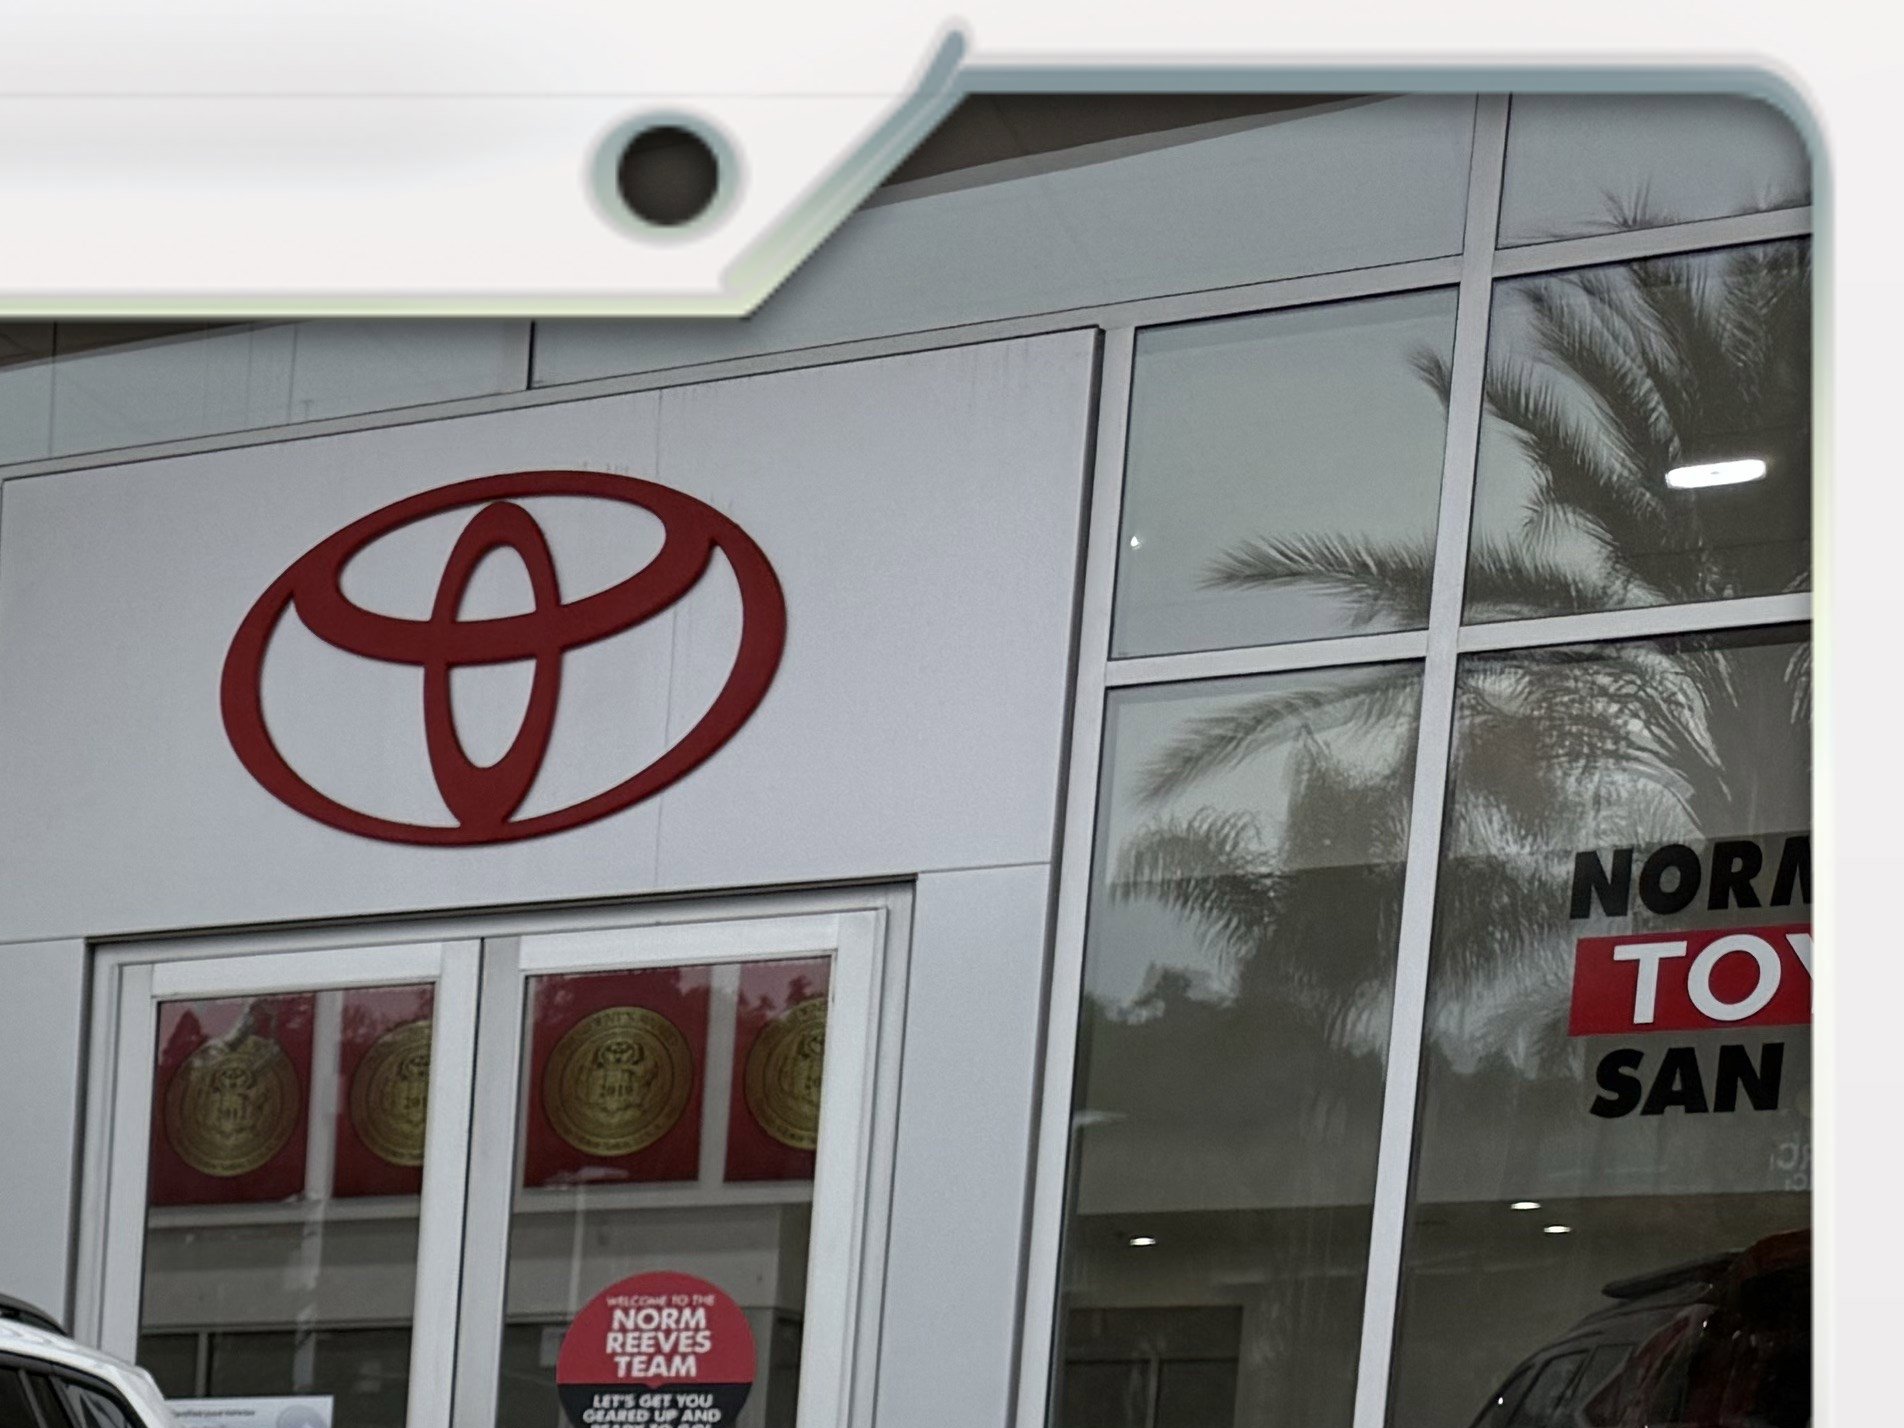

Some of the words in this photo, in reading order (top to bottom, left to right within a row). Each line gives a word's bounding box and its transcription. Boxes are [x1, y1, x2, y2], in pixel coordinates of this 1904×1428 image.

[1589, 1042, 1785, 1119] SAN
[606, 1295, 667, 1308] WELCOME
[671, 1294, 689, 1307] TO
[692, 1294, 716, 1307] THE
[611, 1307, 707, 1331] NORM
[606, 1330, 713, 1355] REEVES
[613, 1354, 698, 1379] TEAM
[592, 1393, 636, 1409] LET'S
[639, 1393, 673, 1409] GET
[676, 1392, 715, 1408] YOU
[582, 1408, 650, 1424] GEARED
[654, 1408, 679, 1423] UP
[681, 1408, 722, 1423] AND
